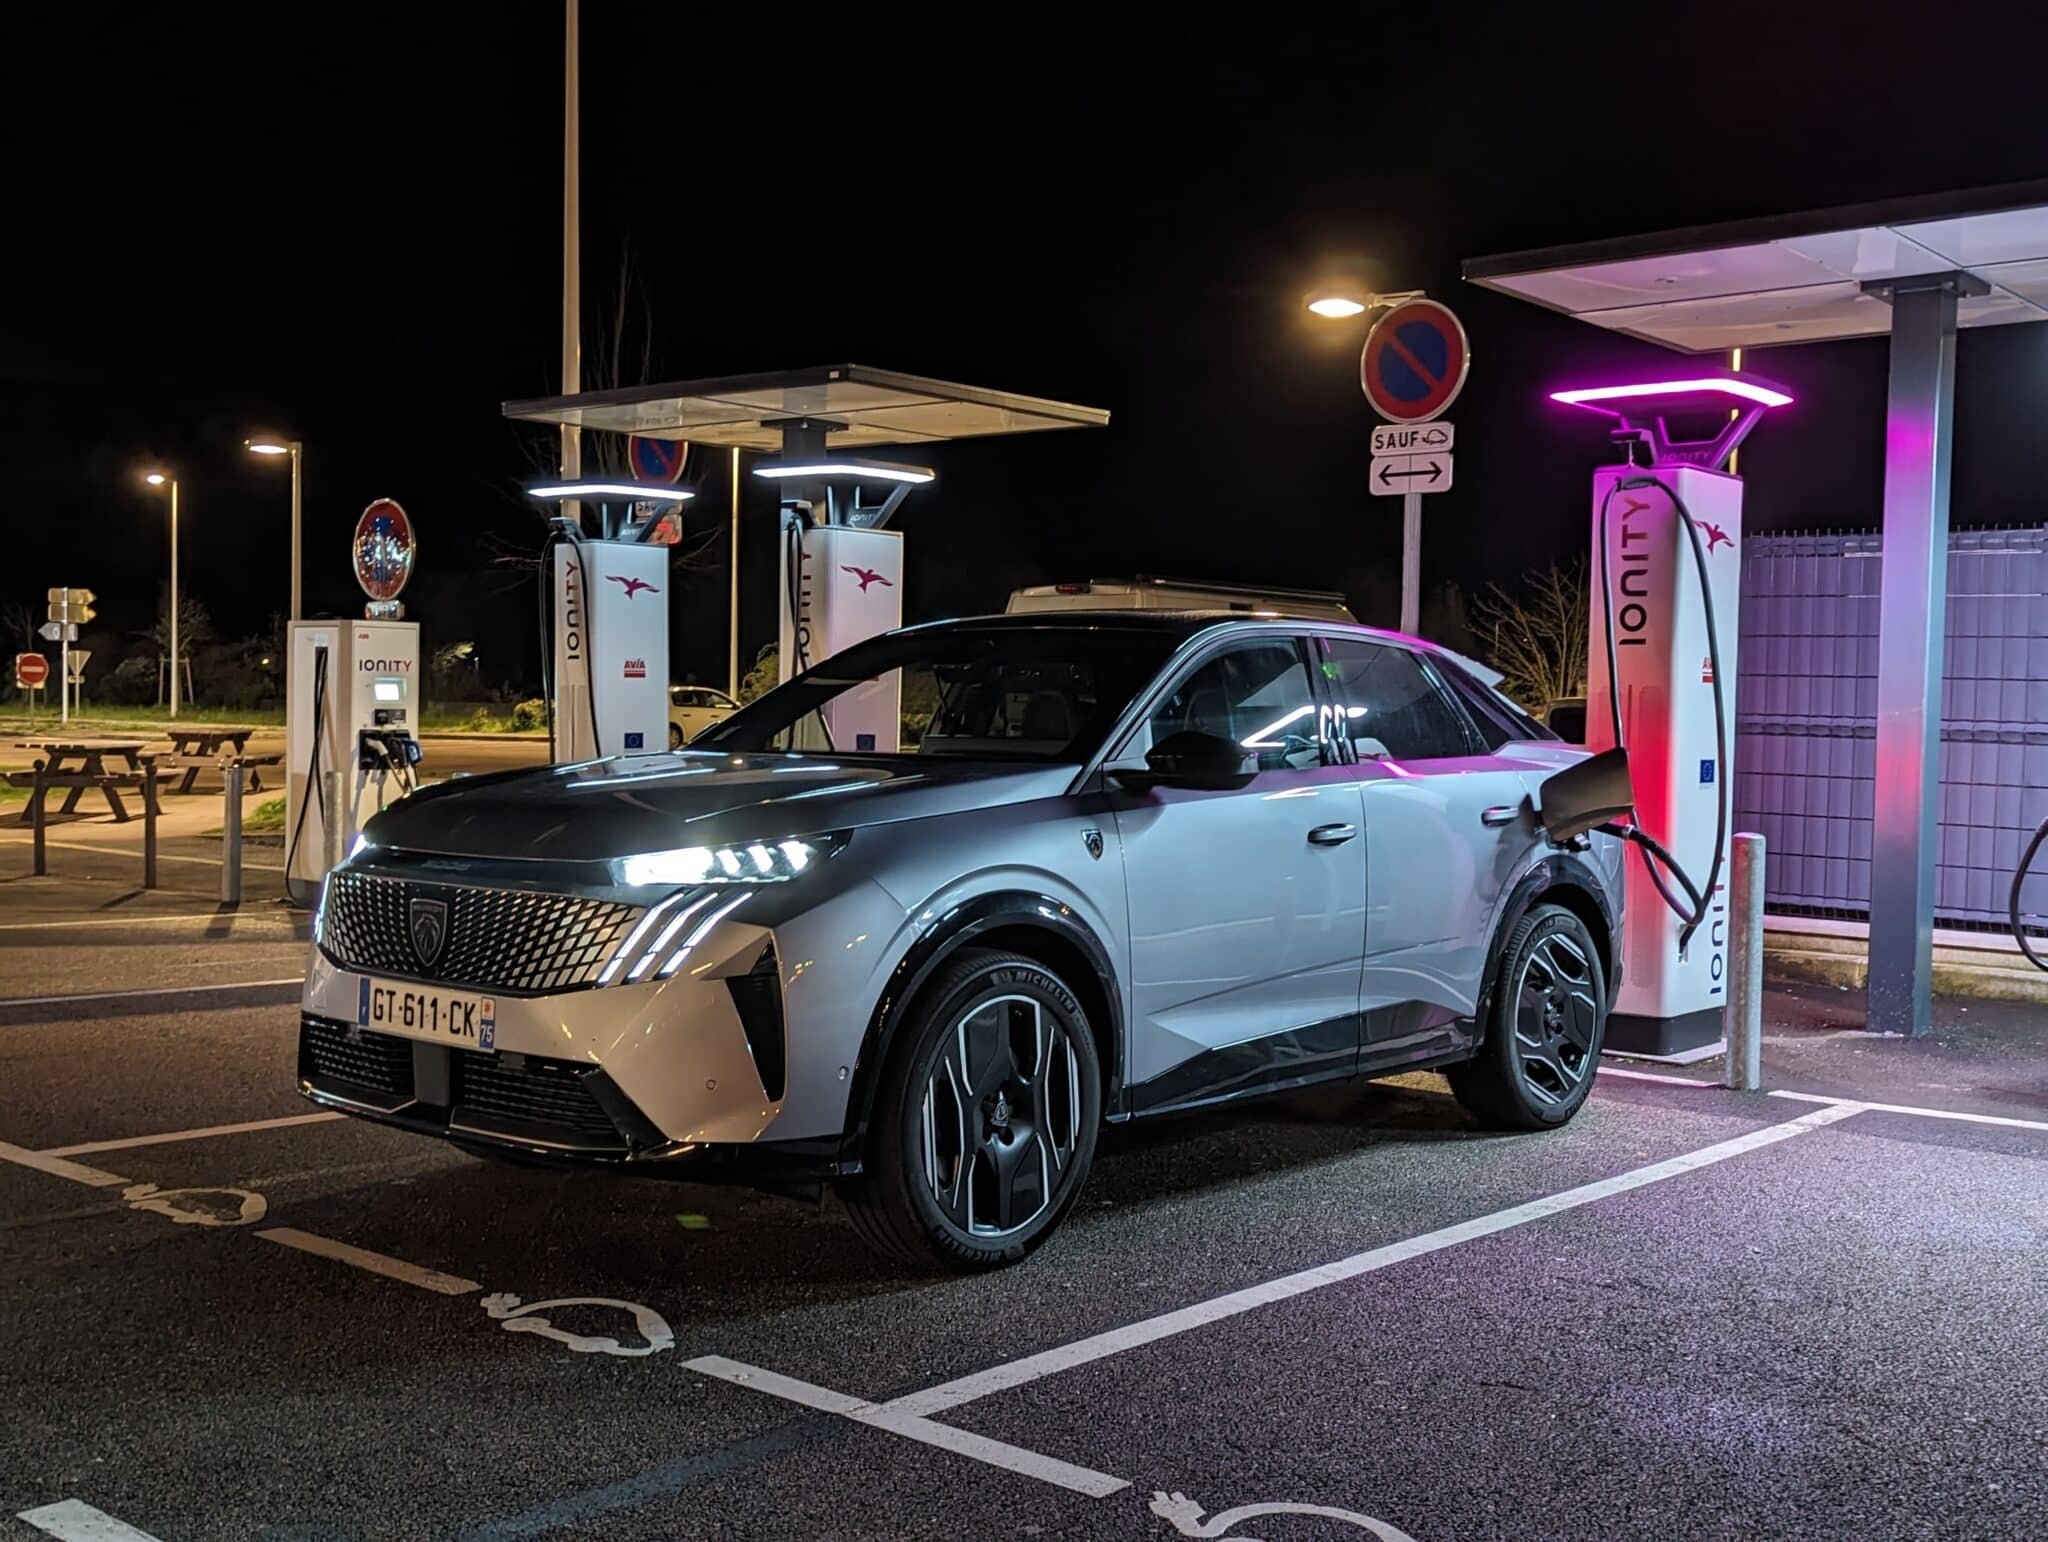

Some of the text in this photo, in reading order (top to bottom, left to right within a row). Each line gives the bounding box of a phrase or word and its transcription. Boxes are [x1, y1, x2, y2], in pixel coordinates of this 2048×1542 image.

[1375, 430, 1420, 449] SAUF
[1619, 496, 1651, 645] IONITY
[566, 560, 580, 660] IONITY
[359, 659, 413, 672] IONITY
[624, 658, 645, 669] AVIA
[1016, 971, 1074, 1012] MICHELIN
[480, 1024, 494, 1043] 75
